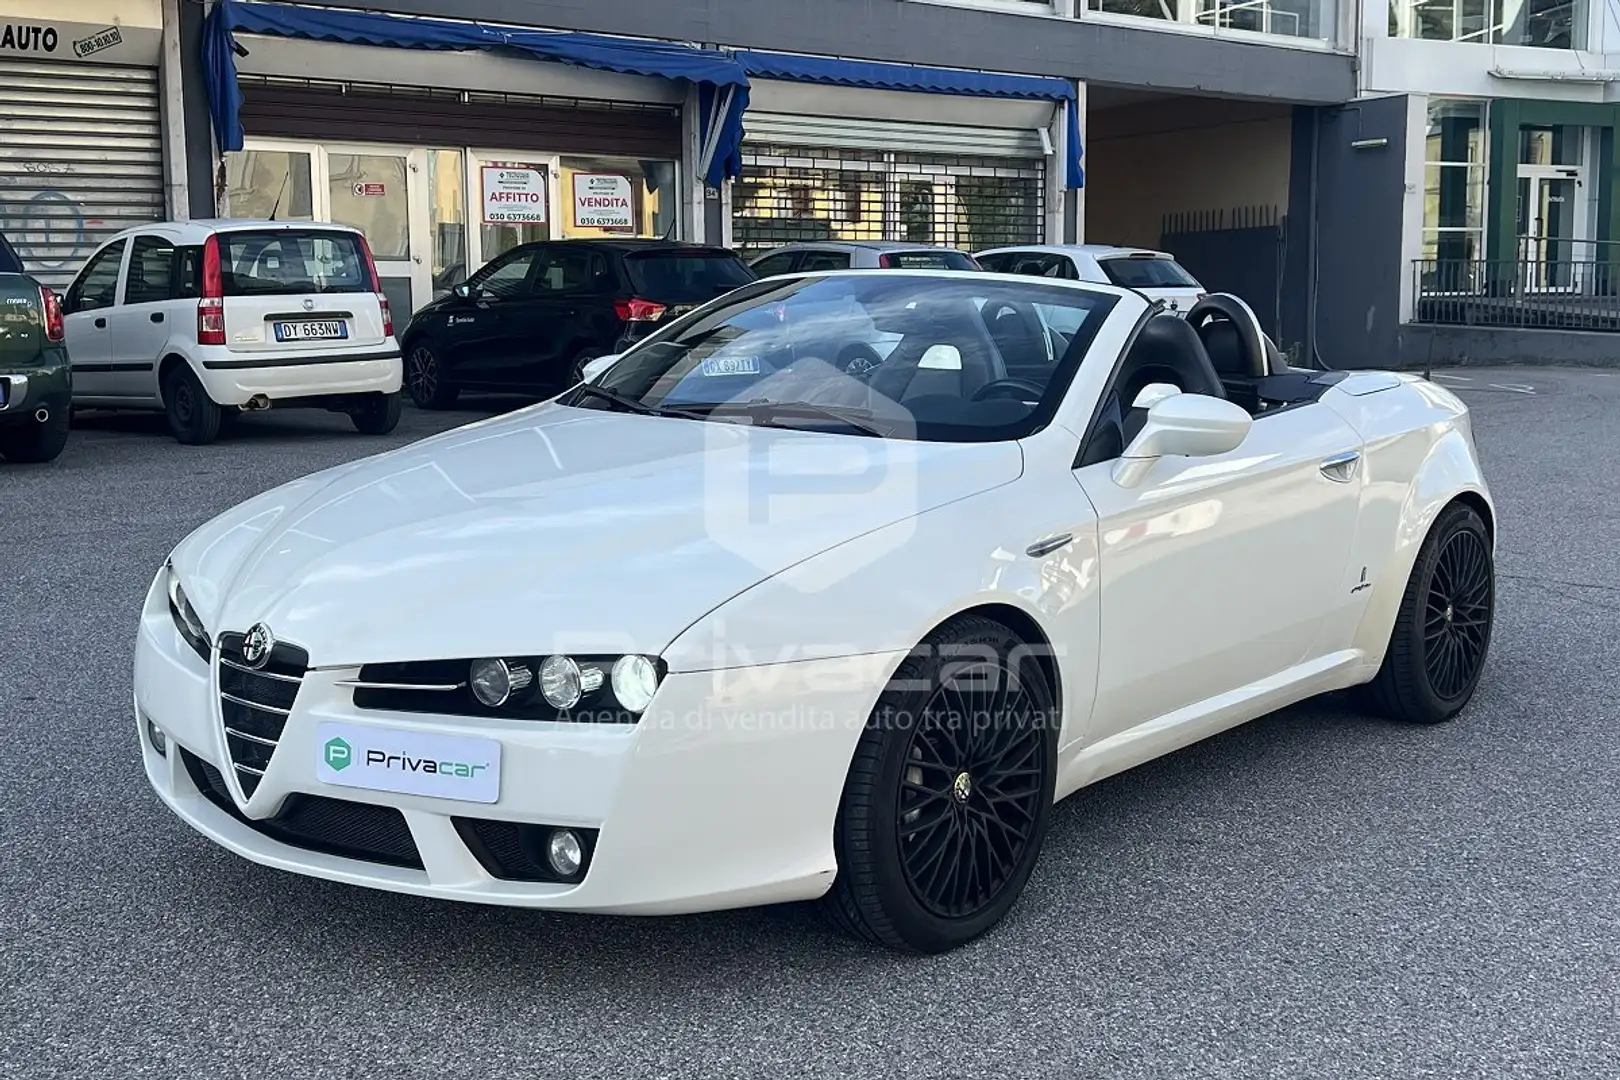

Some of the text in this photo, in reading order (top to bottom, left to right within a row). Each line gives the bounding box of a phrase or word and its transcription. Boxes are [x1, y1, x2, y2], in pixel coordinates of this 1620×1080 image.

[489, 191, 540, 204] AFFITTO
[579, 197, 629, 208] VENDITA
[507, 213, 541, 221] 6373668
[580, 217, 629, 225] 030 6373668
[283, 324, 298, 337] DY
[366, 750, 488, 778] Privacar
